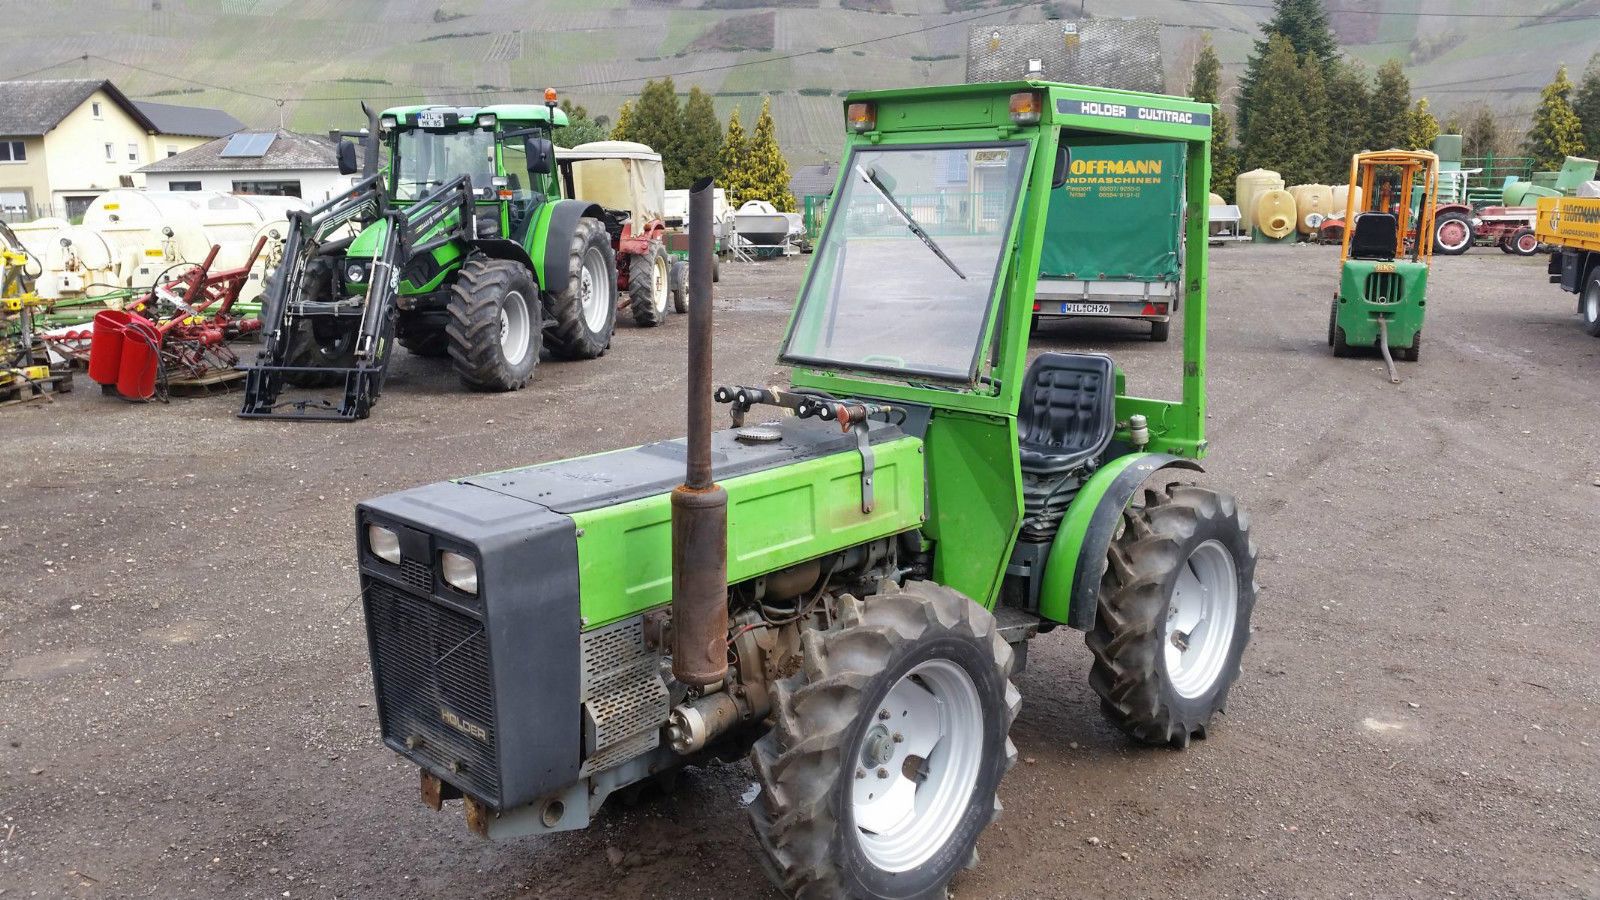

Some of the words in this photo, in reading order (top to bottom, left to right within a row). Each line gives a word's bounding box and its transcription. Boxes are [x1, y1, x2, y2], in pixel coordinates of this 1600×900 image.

[1081, 102, 1126, 118] HOLDER
[1138, 108, 1193, 124] CULTITRAC
[1070, 159, 1162, 175] OFFMANN
[1066, 304, 1082, 313] WIL
[441, 709, 486, 740] HOLDER
